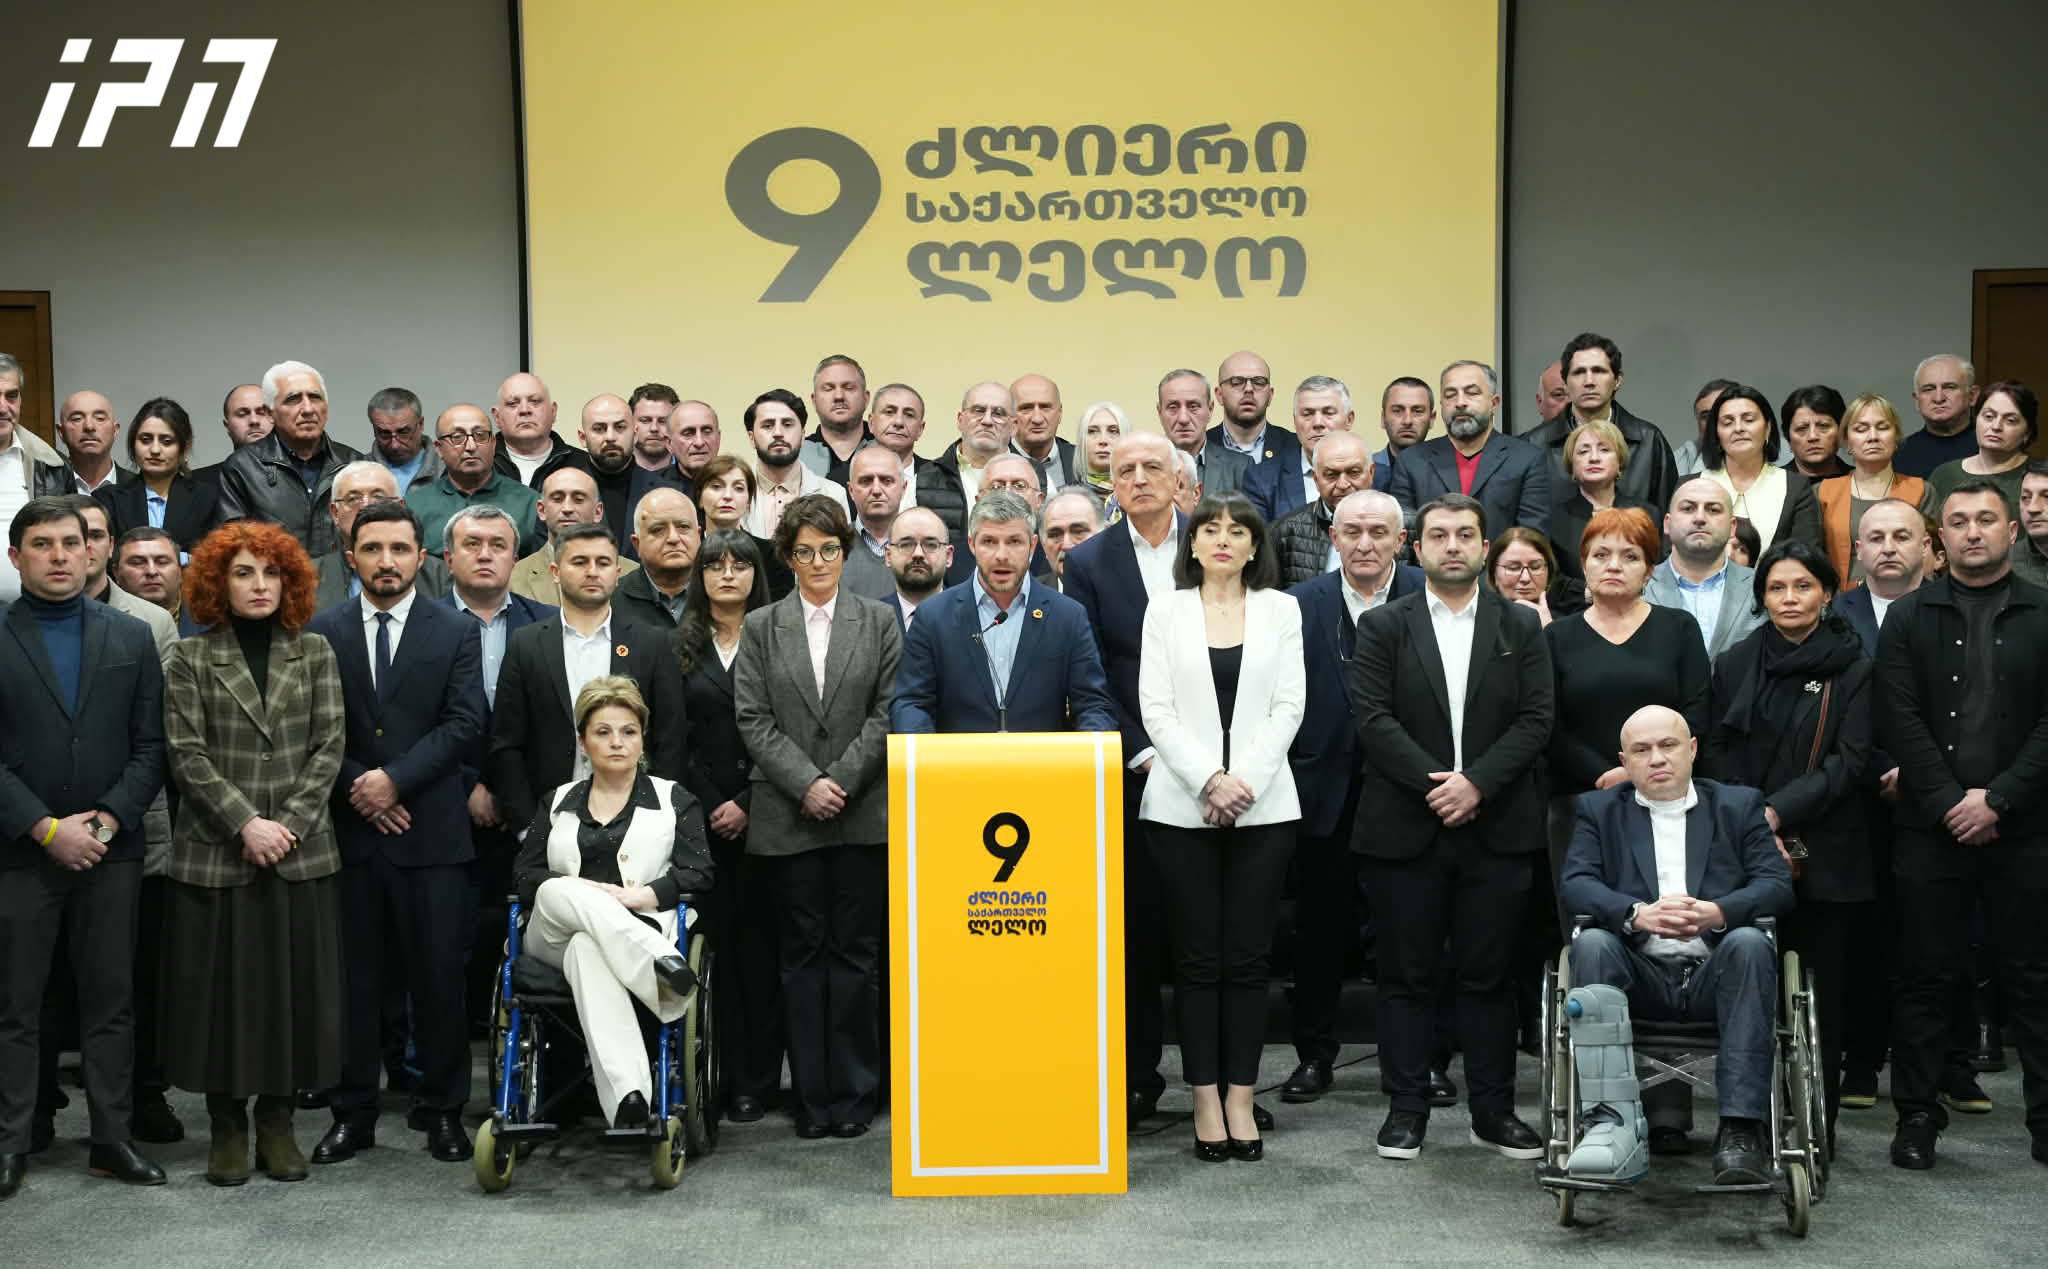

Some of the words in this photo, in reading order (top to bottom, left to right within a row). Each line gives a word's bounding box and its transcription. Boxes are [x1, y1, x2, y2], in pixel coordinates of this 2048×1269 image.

[905, 121, 1307, 178] ძლიერი
[725, 126, 882, 303] 9
[905, 186, 1307, 223] საქართველო
[907, 235, 1307, 302] ლელო
[983, 812, 1030, 882] 9
[967, 907, 1047, 918] საქართველო
[968, 891, 1047, 906] ძლიერი
[967, 919, 1047, 937] ლელო
